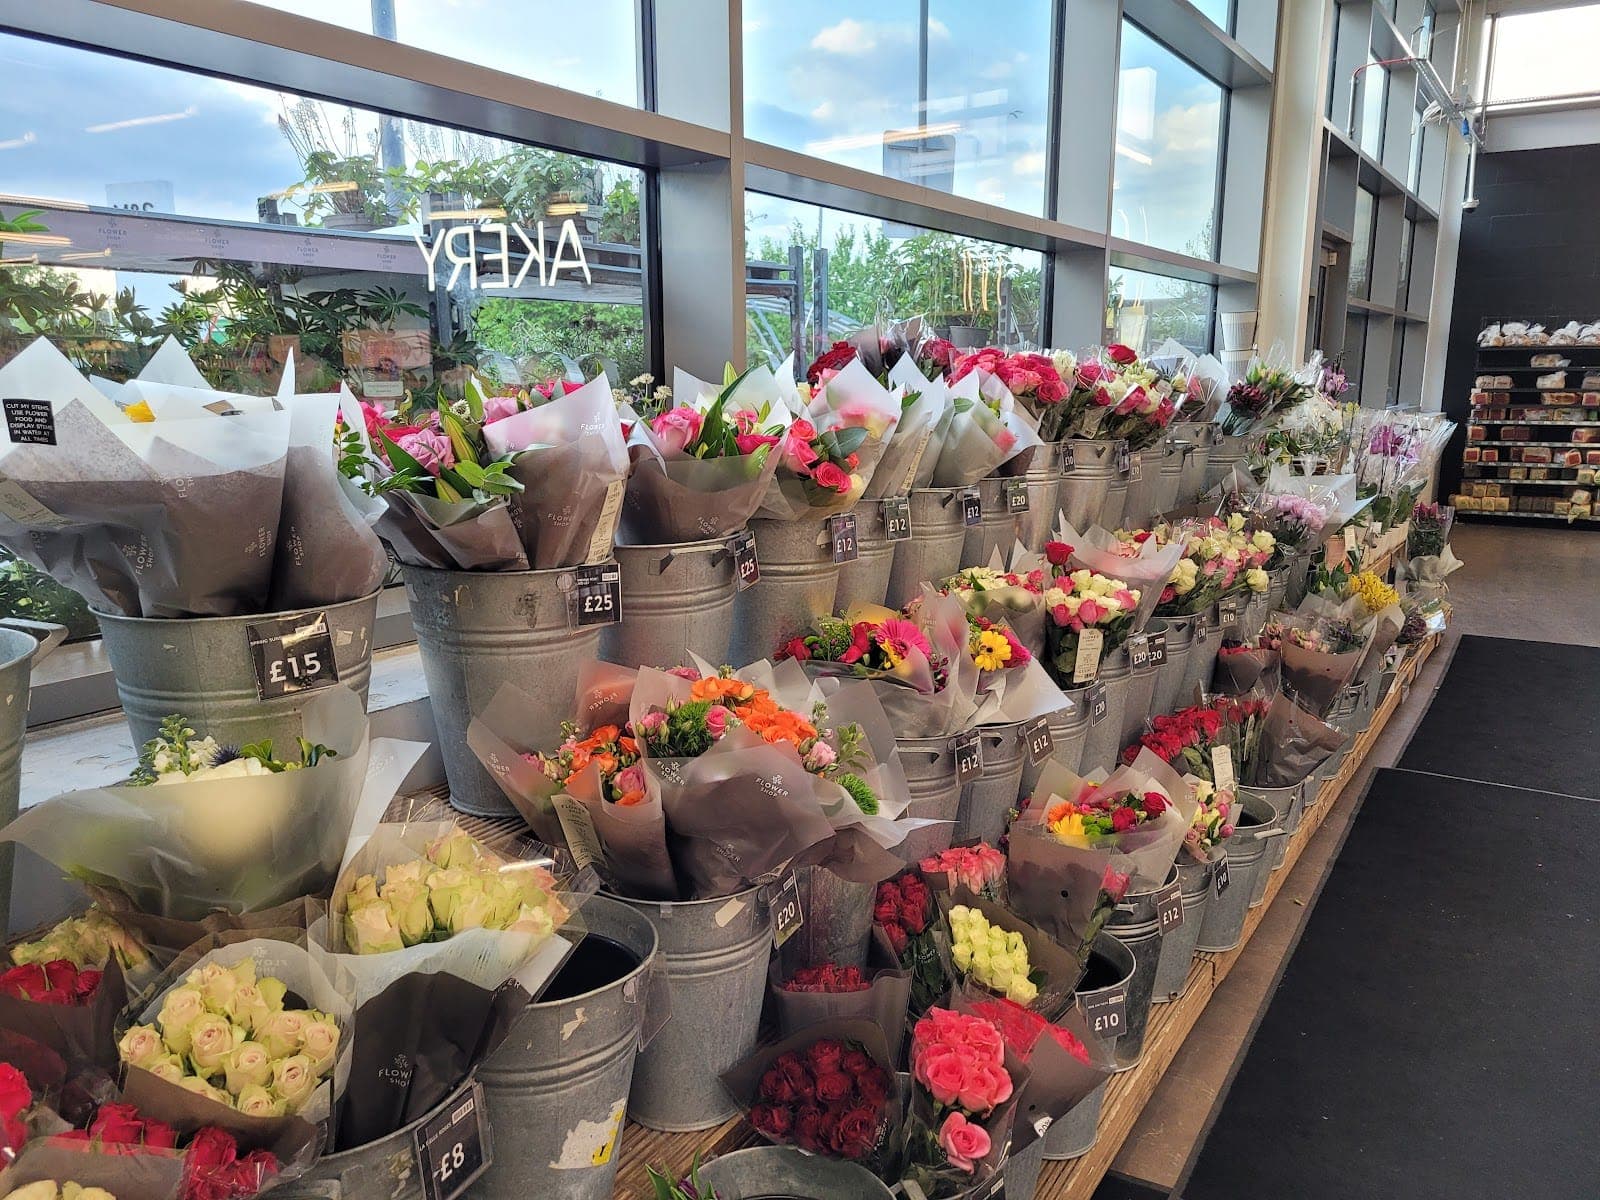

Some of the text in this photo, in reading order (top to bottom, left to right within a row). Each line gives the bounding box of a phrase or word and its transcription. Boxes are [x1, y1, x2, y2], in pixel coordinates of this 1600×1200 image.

[1011, 495, 1026, 507] £20
[967, 505, 980, 519] £12
[889, 518, 907, 532] £12
[837, 537, 853, 553] £12
[740, 558, 755, 579] £25
[584, 594, 613, 613] £25
[1223, 613, 1235, 623] £10
[1133, 652, 1146, 665] £20
[269, 652, 321, 684] £15
[1033, 734, 1048, 754] £12
[961, 754, 979, 773] £12
[656, 760, 685, 786] FLOWER
[755, 777, 789, 797] FLOWER
[760, 787, 778, 797] SHOP
[1217, 872, 1227, 890] £10
[777, 901, 795, 930] £20
[1163, 907, 1179, 925] £12
[1095, 1013, 1119, 1031] £10
[378, 1068, 413, 1079] FLOW
[440, 1142, 465, 1182] £8
